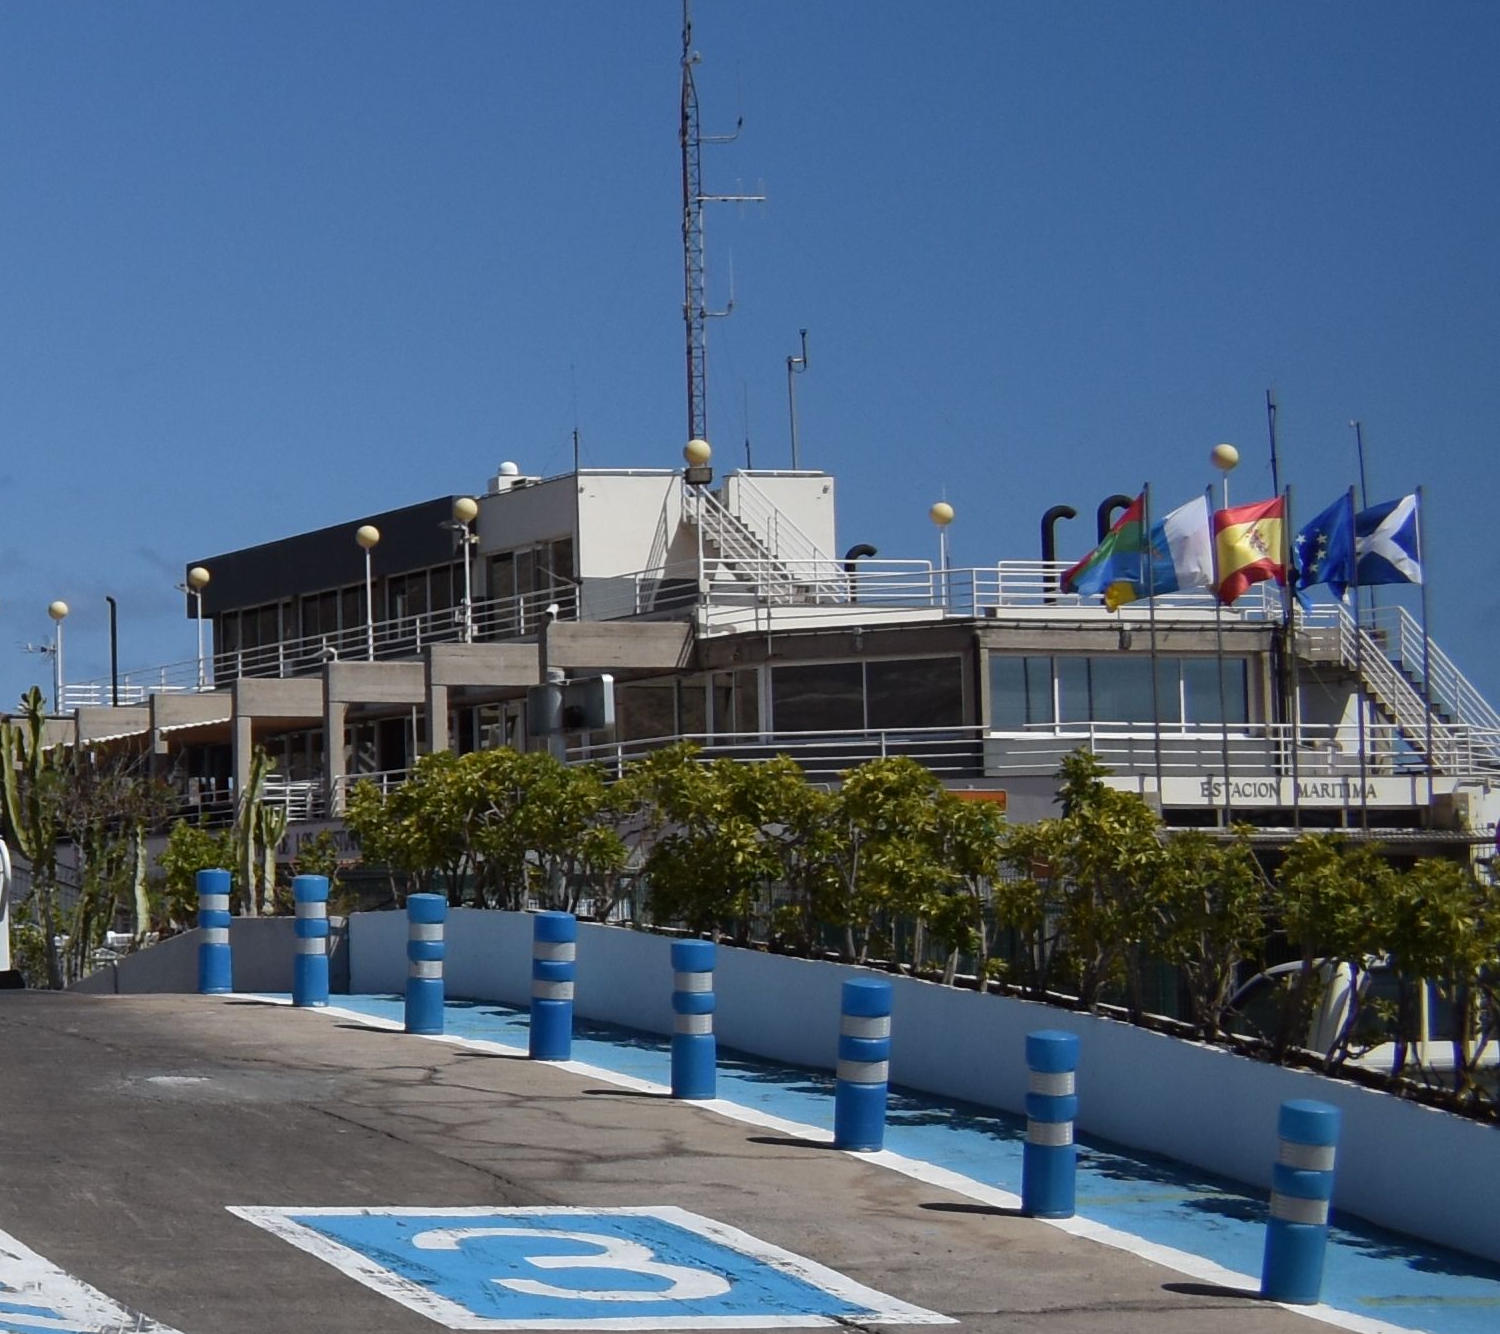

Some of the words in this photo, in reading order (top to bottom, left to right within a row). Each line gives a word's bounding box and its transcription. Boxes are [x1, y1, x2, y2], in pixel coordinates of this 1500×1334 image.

[1200, 781, 1282, 799] ESTACION
[1296, 782, 1378, 799] MARITIMA
[411, 1226, 731, 1302] 3
